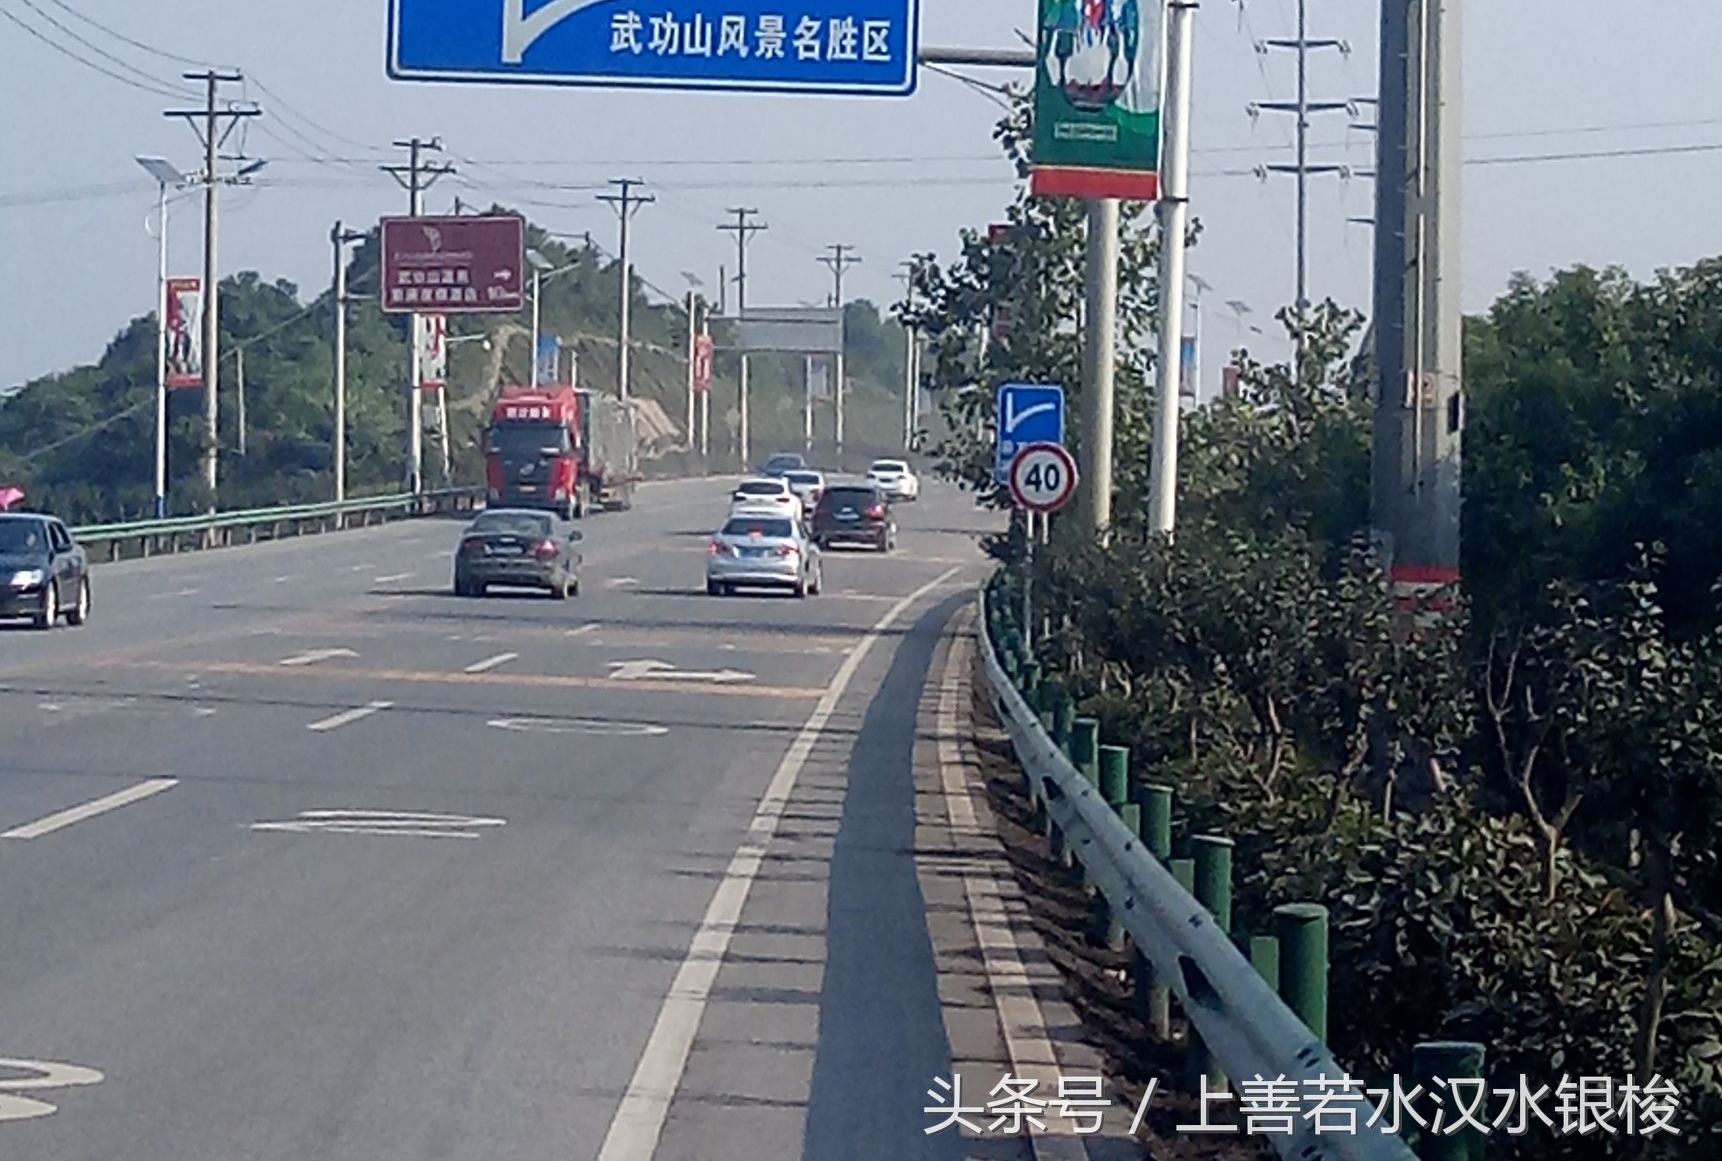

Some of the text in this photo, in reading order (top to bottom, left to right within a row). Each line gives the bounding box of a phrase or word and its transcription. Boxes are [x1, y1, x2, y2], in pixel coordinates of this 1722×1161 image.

[610, 11, 892, 61] 武功山风景名胜区
[1025, 463, 1060, 492] 40
